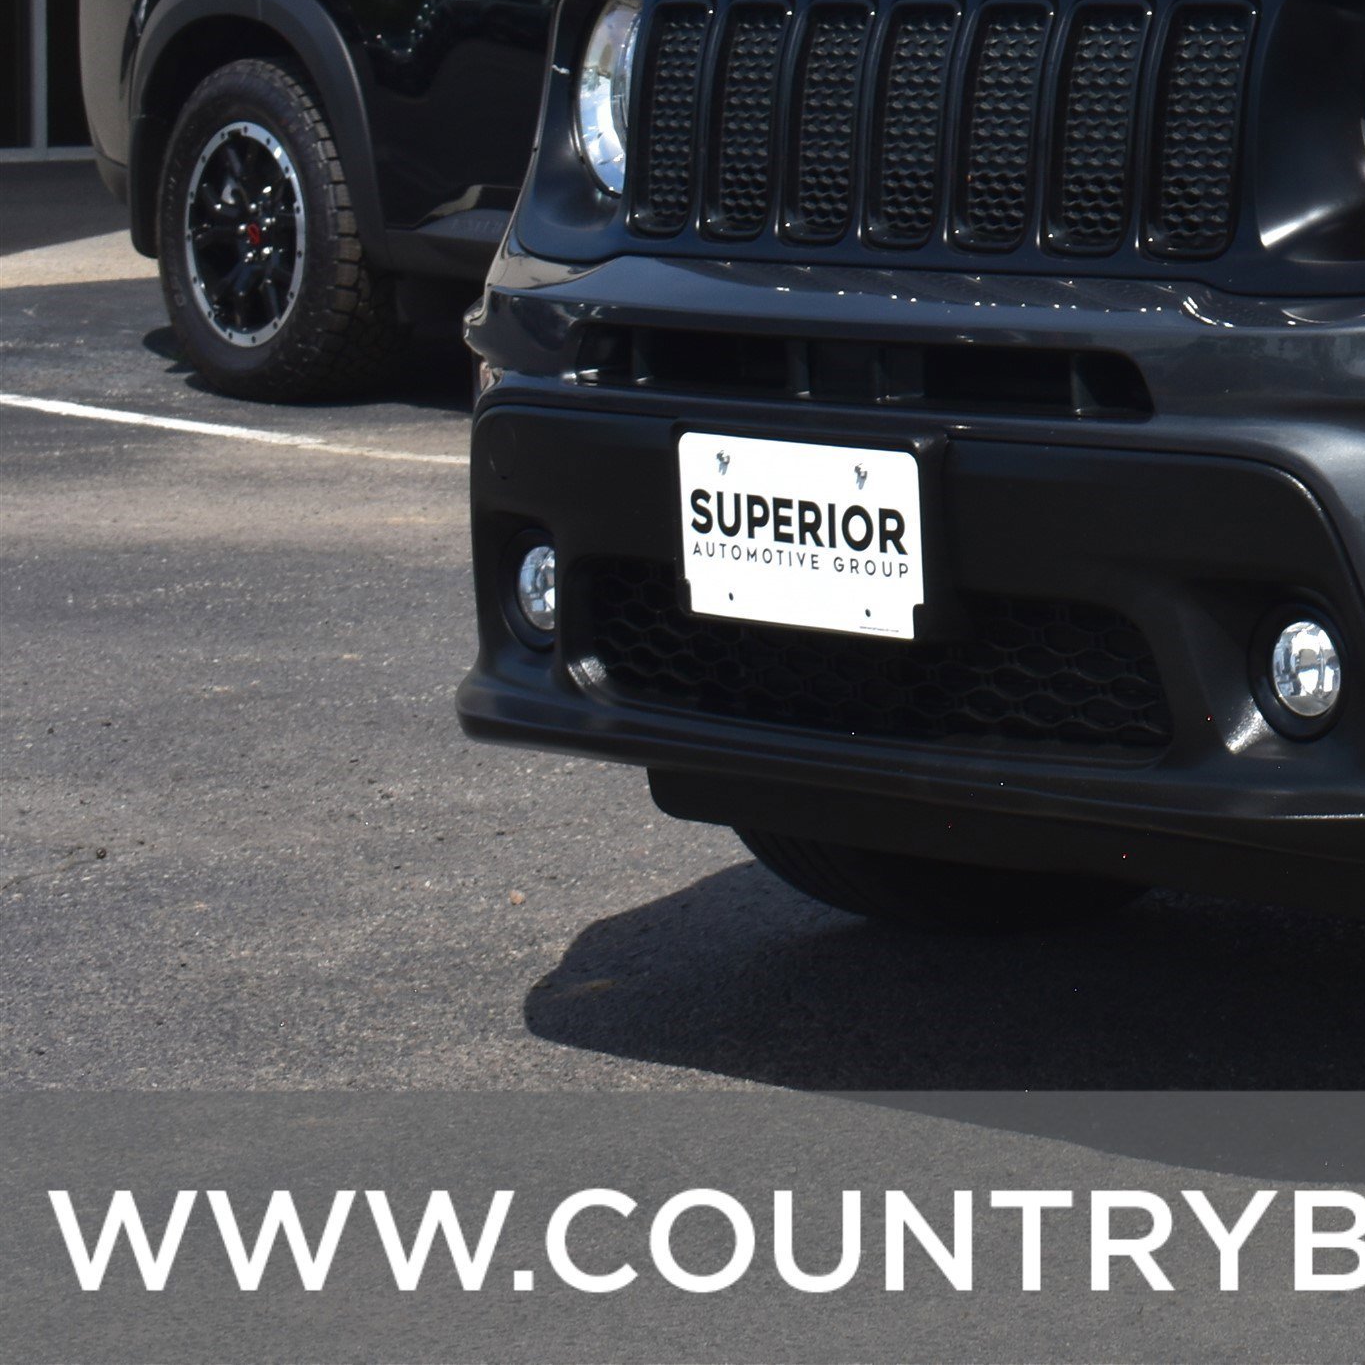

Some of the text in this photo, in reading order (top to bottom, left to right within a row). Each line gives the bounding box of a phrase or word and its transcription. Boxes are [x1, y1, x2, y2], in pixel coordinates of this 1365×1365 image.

[690, 488, 909, 556] SUPERIOR
[693, 541, 909, 579] AUTOMOTIVE GROUP
